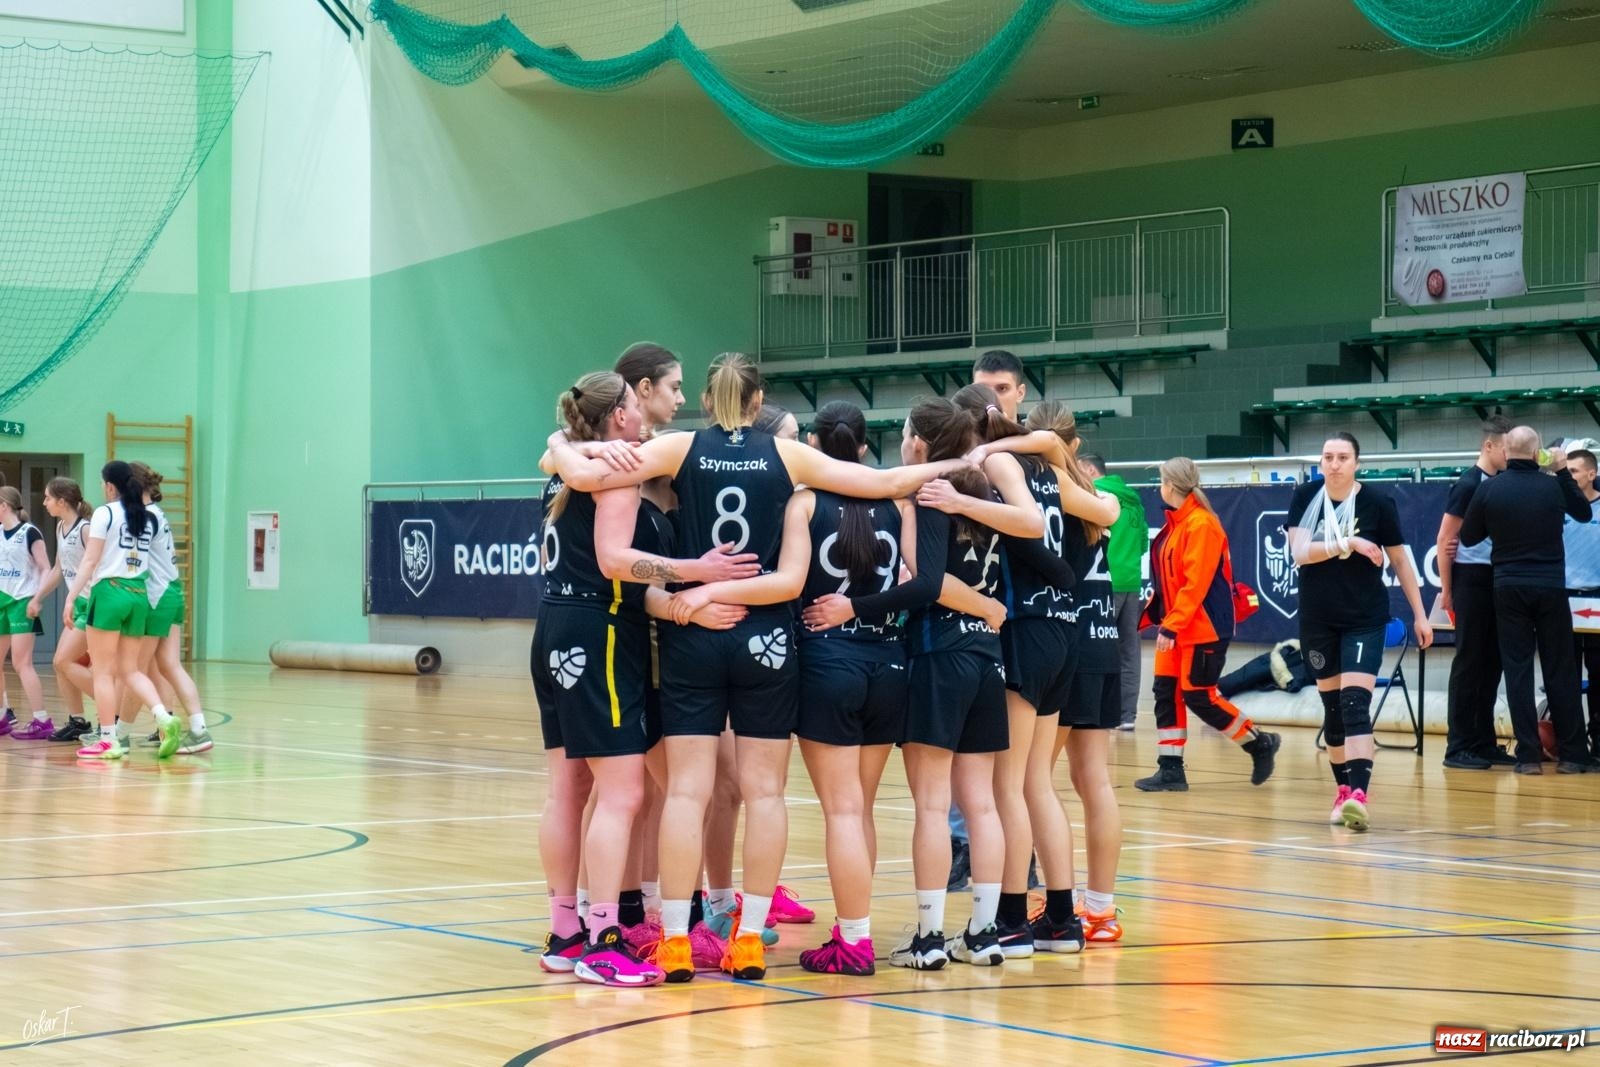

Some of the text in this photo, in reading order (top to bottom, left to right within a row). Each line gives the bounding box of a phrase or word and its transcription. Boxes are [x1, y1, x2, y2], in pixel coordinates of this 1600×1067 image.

[1238, 128, 1266, 145] A
[1411, 181, 1510, 217] MIESZKO
[1413, 224, 1522, 243] Operator urządzeń cukierniczych
[1414, 239, 1489, 252] Pracownik produkcyjny
[1451, 255, 1481, 264] Czekamy
[699, 456, 768, 472] Szymczak
[711, 486, 750, 554] 8
[454, 532, 545, 576] RACIBÓ
